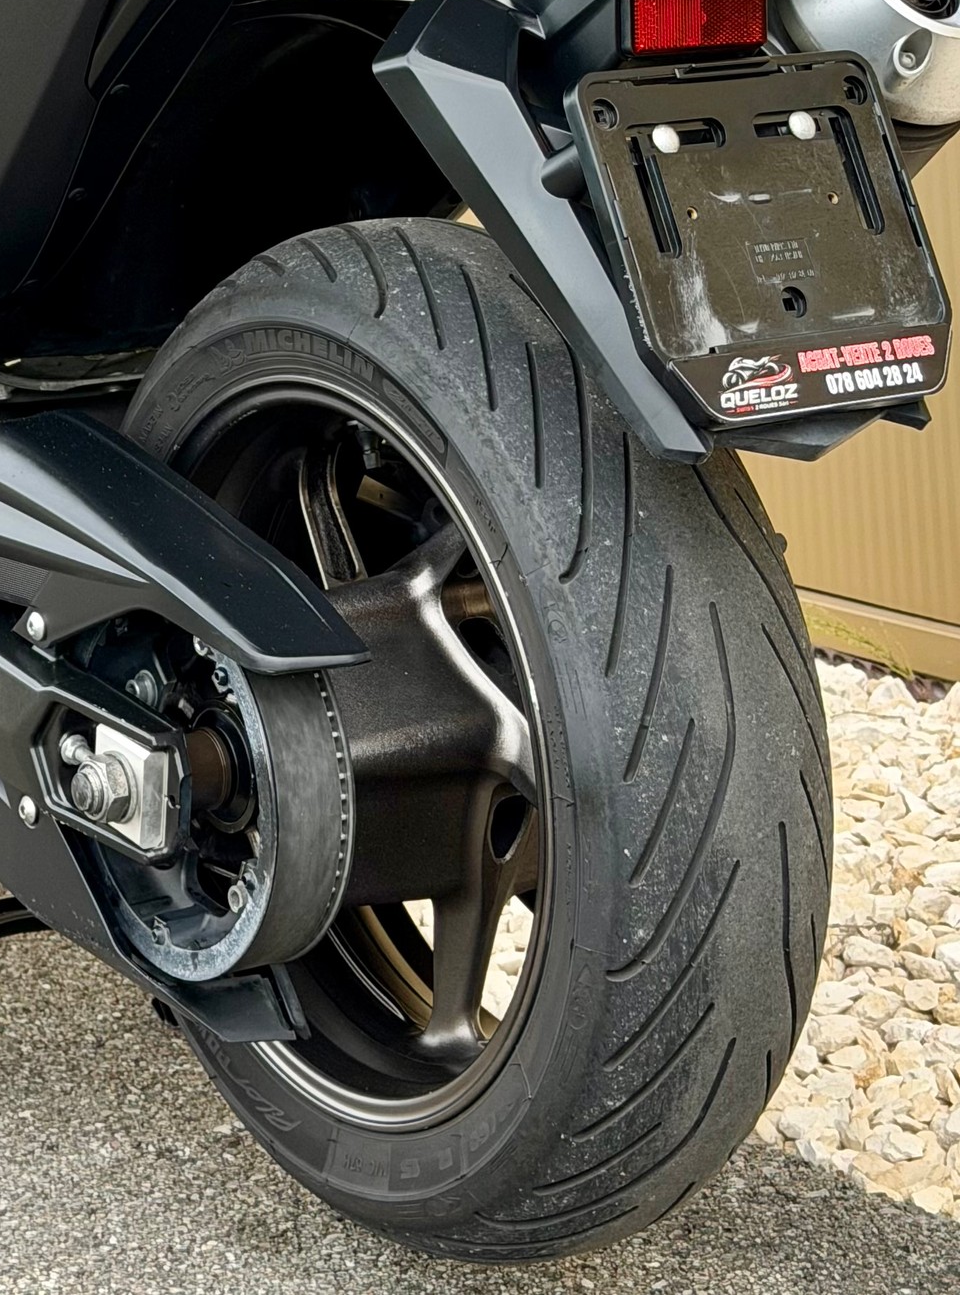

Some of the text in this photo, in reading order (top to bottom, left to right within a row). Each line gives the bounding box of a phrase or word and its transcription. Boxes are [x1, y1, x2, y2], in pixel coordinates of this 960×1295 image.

[243, 328, 376, 383] MICHELIN
[797, 335, 935, 373] ACHAT-VENTE 2 ROUES
[720, 383, 798, 409] QUELOZ
[825, 362, 923, 395] 078 604 28 24
